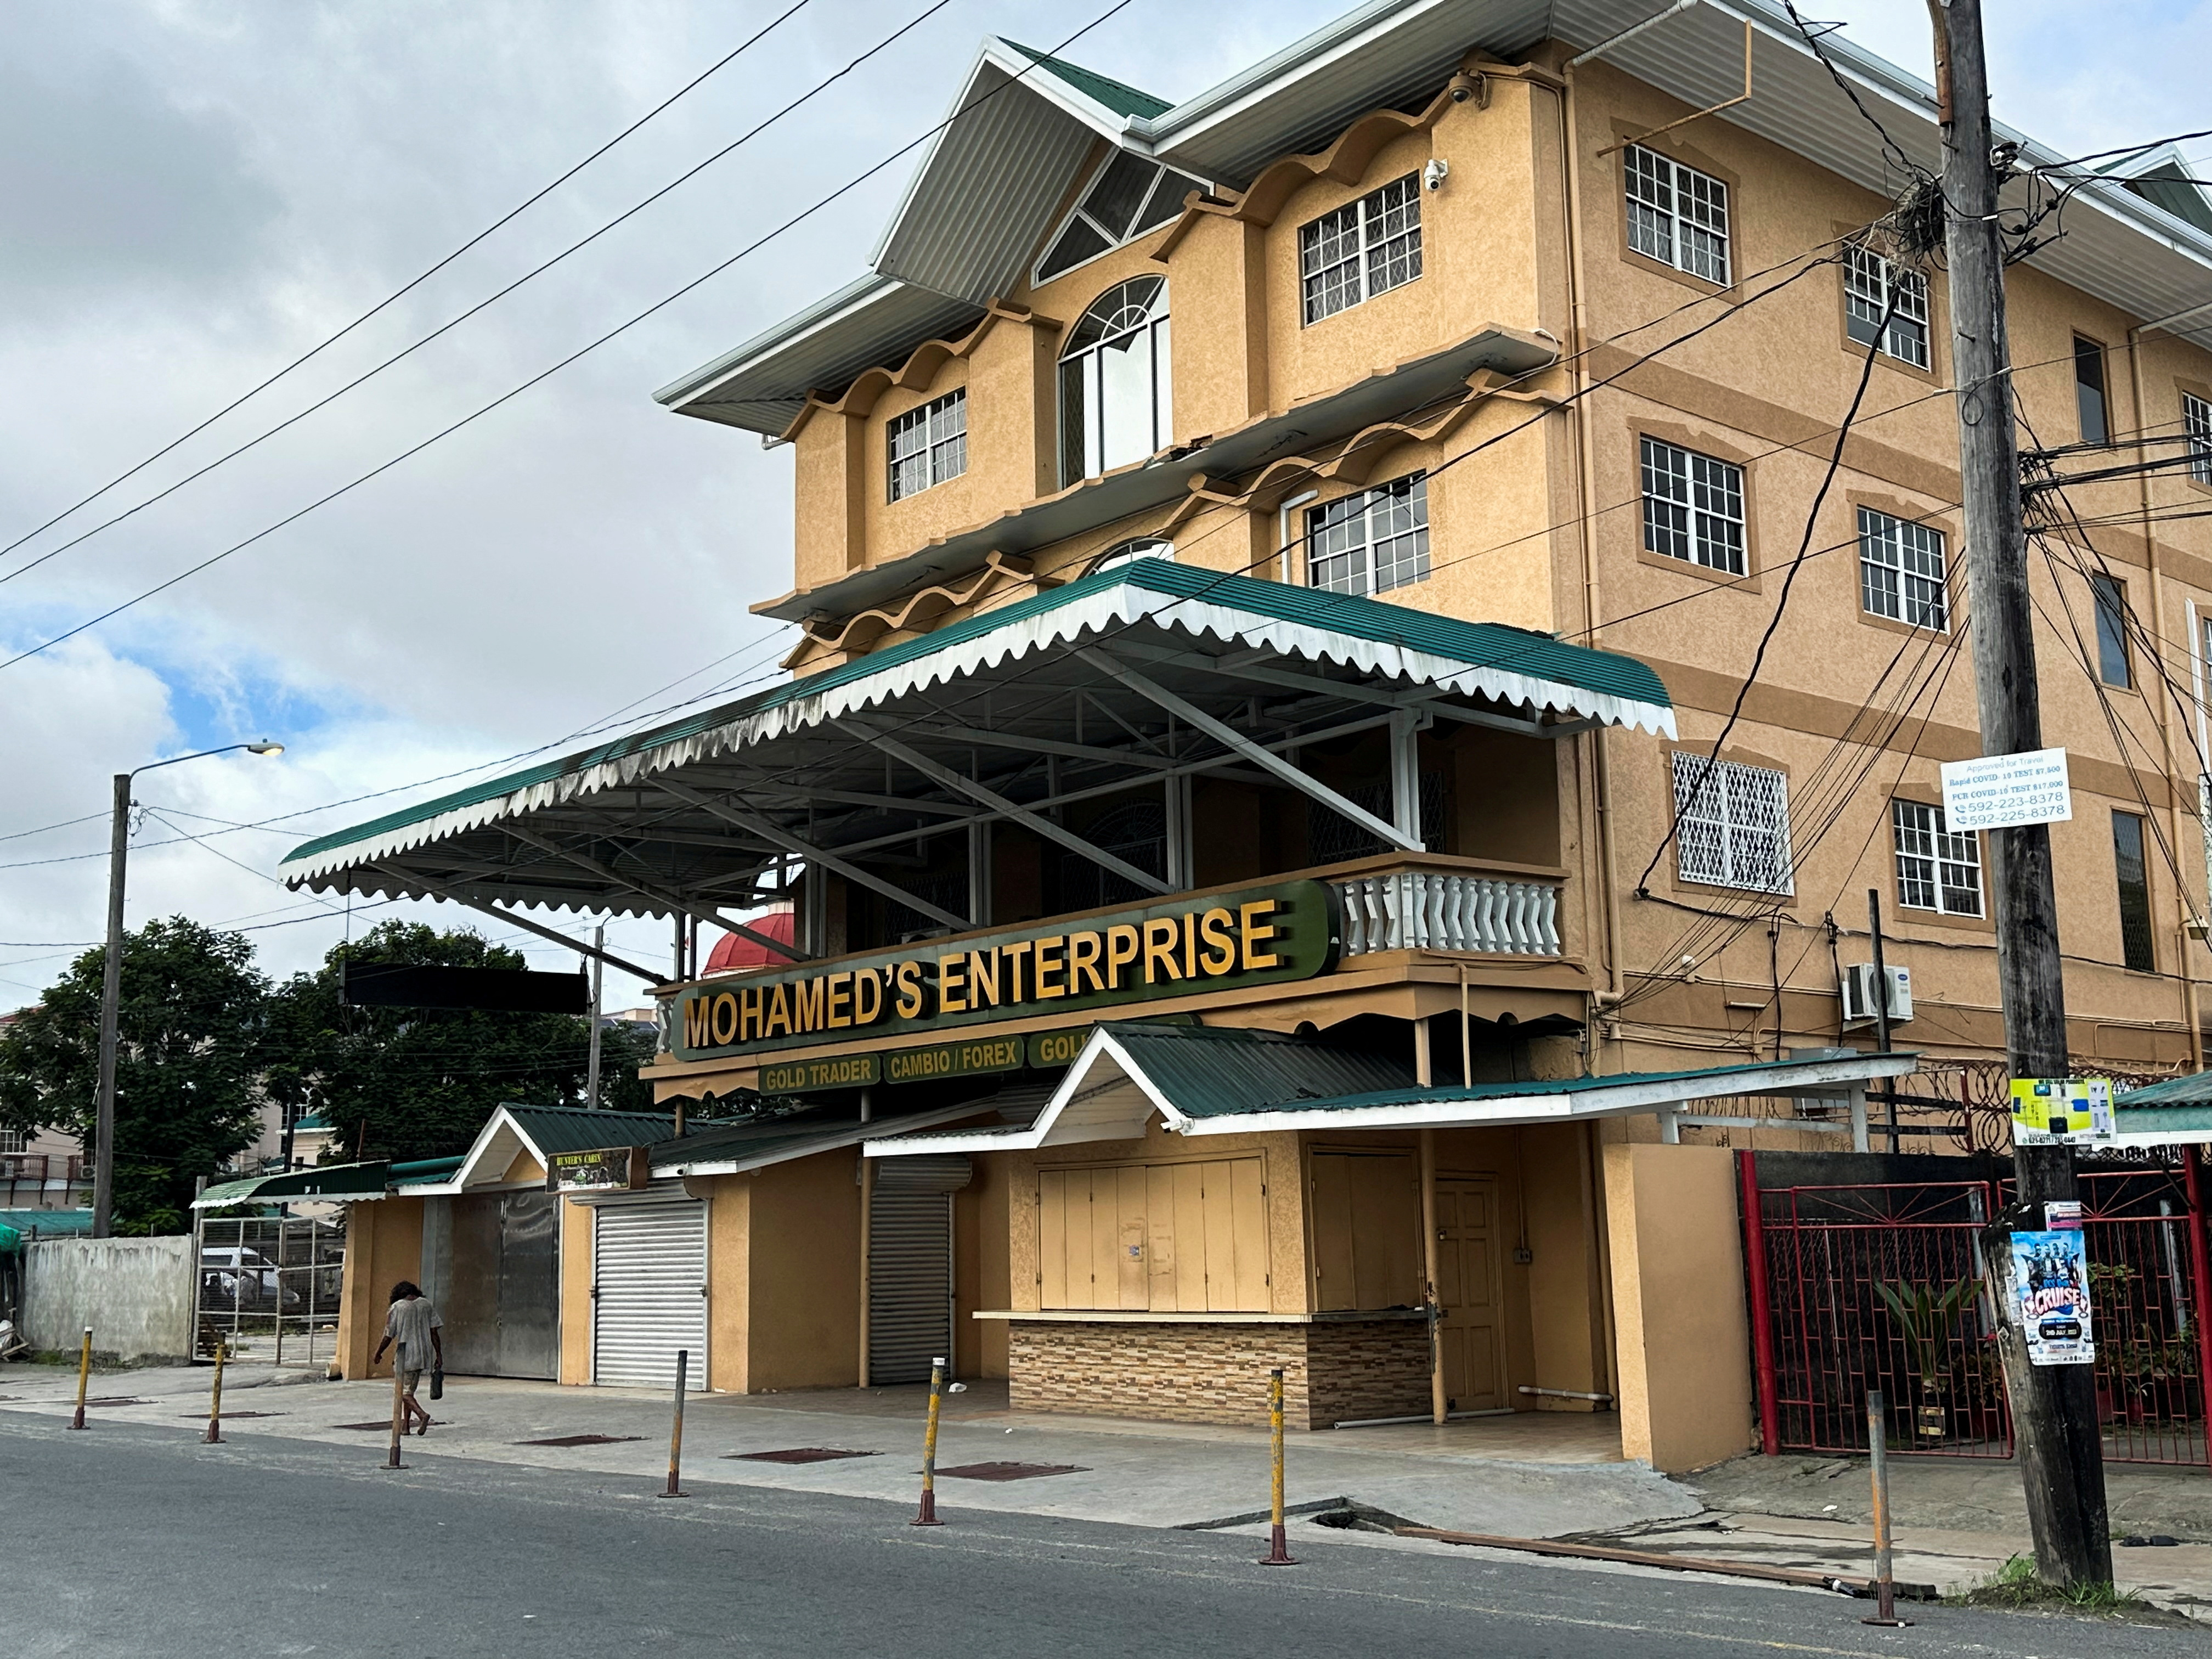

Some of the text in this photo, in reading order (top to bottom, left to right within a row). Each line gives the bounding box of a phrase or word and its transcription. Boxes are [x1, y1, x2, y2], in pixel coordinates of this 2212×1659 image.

[1966, 760, 2005, 773] Approved
[2019, 755, 2044, 765] Travel
[2013, 769, 2034, 778] TEST
[2010, 784, 2031, 793] TEST
[1968, 792, 2063, 812] 592-223-8378
[1970, 804, 2065, 825] 592-225-8378
[683, 899, 1278, 1049] MOHAMED'S ENTERPRISE
[890, 1048, 950, 1078] CAMBIO
[962, 1041, 1016, 1068] FOREX
[766, 1058, 872, 1091] GOLD TRADER
[2034, 1286, 2080, 1315] CRUISE
